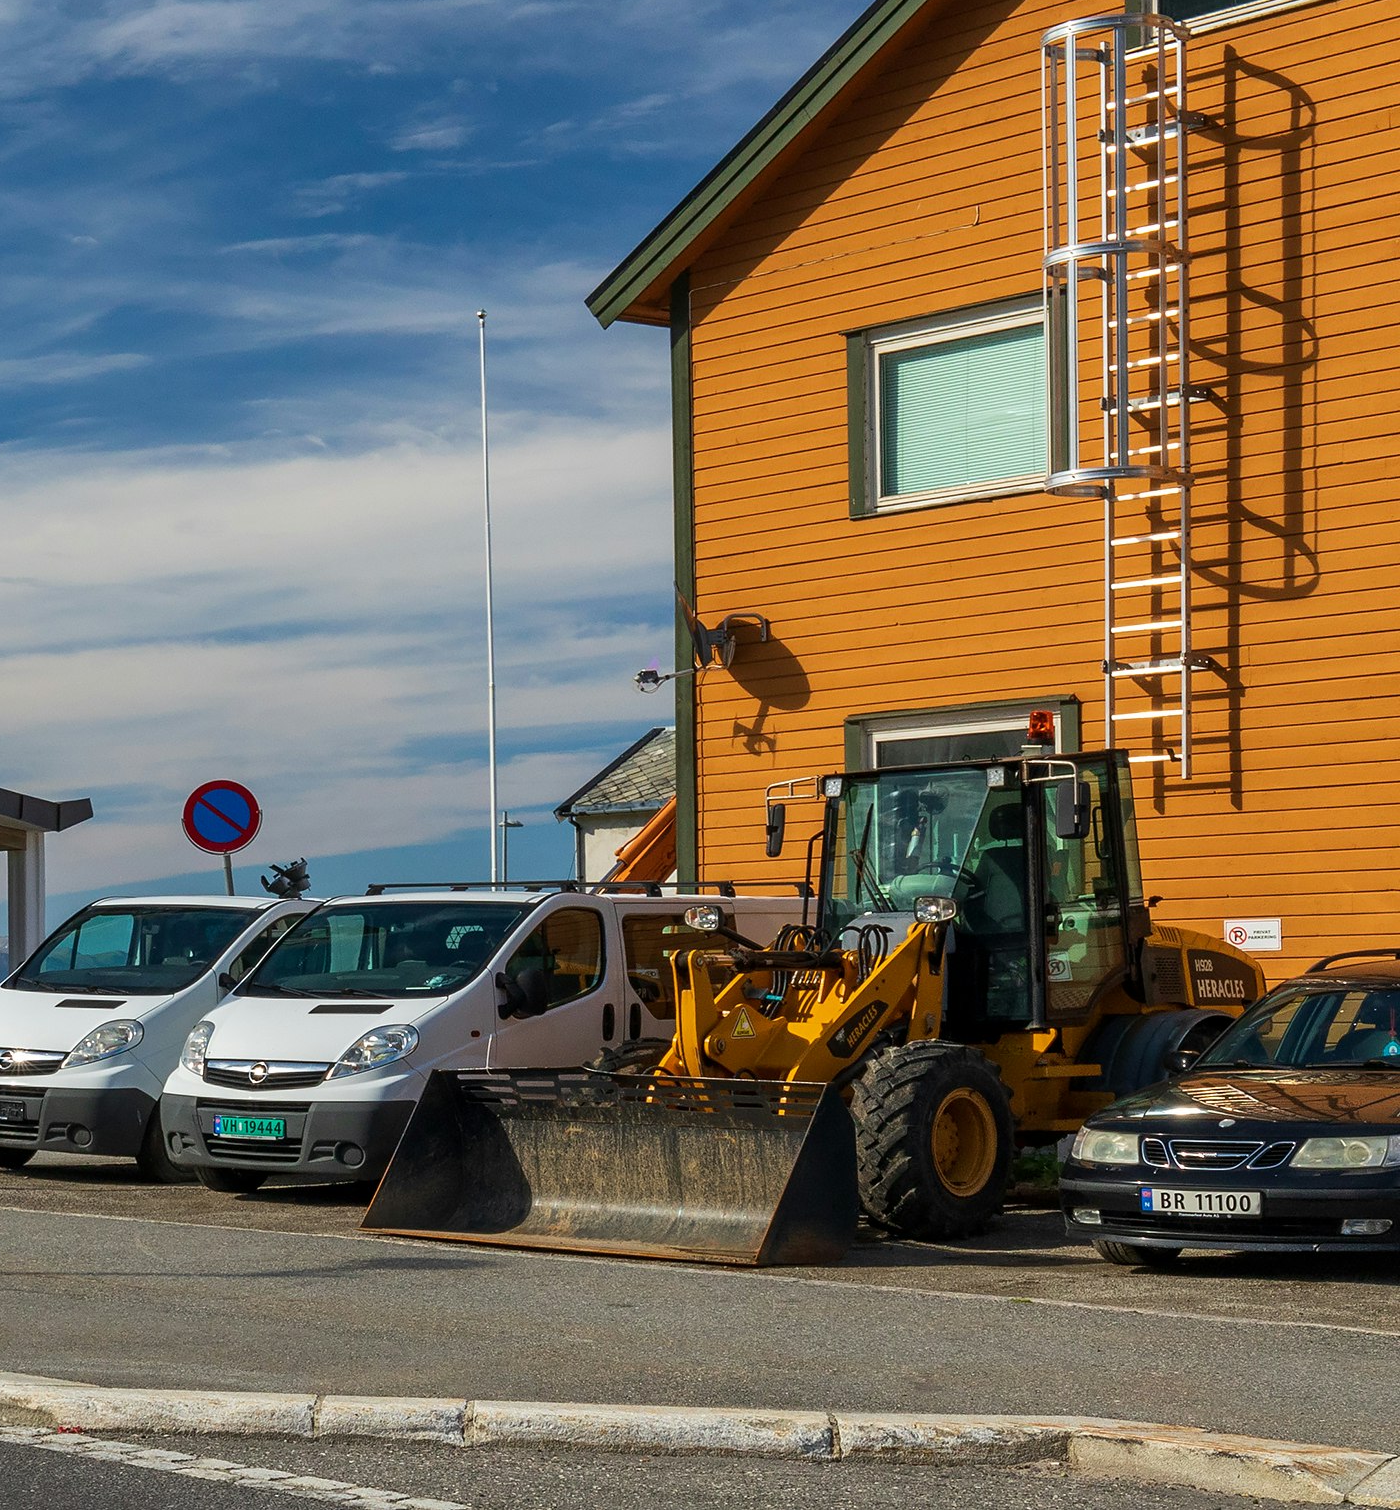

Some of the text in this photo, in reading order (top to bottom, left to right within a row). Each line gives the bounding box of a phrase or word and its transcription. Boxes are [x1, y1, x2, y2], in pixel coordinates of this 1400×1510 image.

[1194, 959, 1213, 972] H928
[1197, 978, 1245, 998] HERACLES
[846, 1004, 878, 1048] HERACLES
[222, 1118, 282, 1135] VH 19444
[1160, 1192, 1251, 1212] BR 11100
